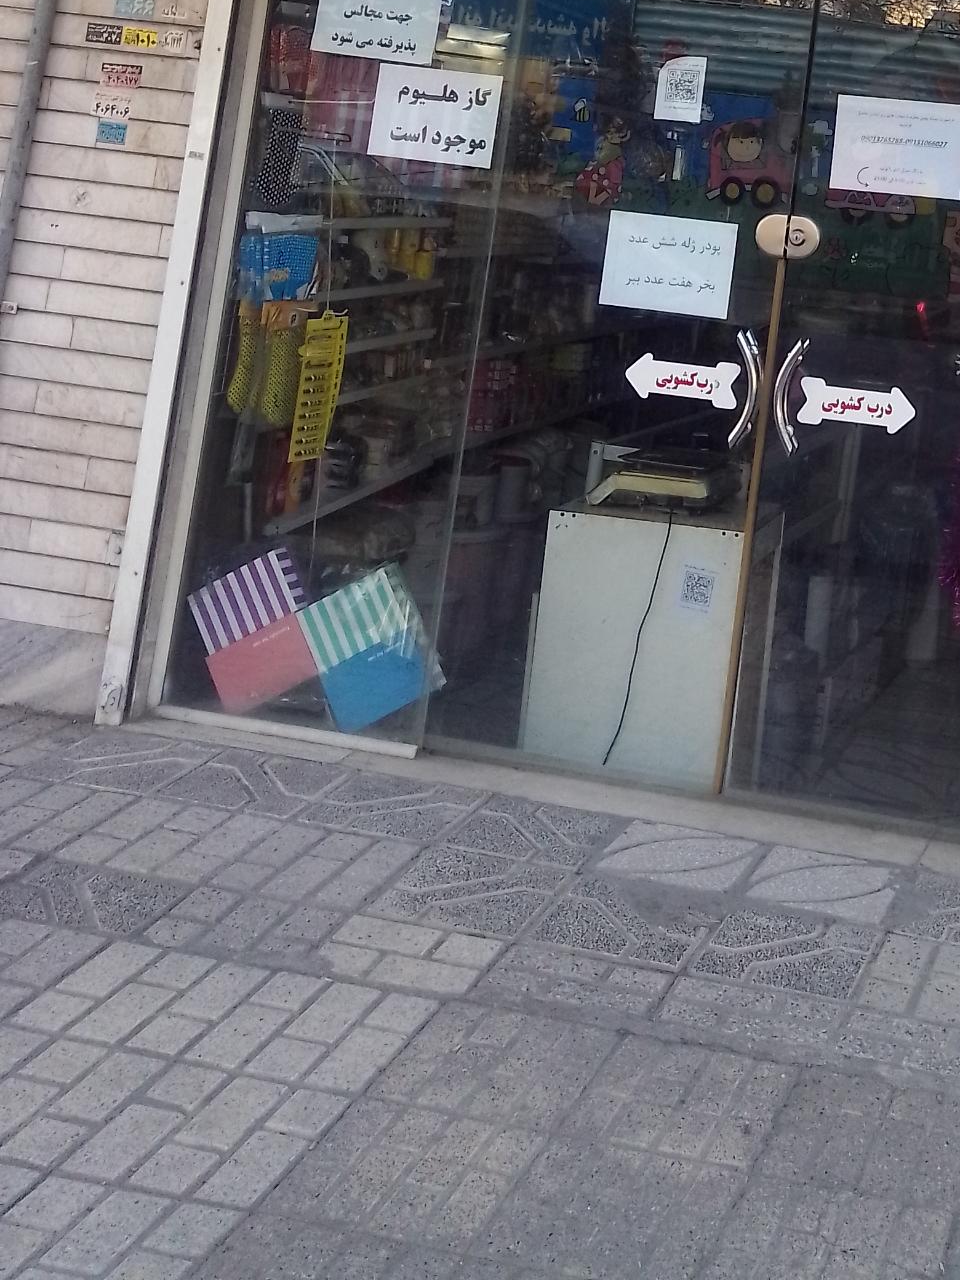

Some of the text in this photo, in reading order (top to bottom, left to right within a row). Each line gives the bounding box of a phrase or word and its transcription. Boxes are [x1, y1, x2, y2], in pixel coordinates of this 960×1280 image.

[343, 4, 413, 26] جهت مجالس
[331, 32, 417, 56] پذیرفته می شود
[397, 83, 492, 111] گاز هلیوم
[389, 125, 487, 155] موجود است
[628, 235, 721, 255] پودر ژله شش عدد
[644, 275, 664, 285] عدد
[668, 276, 693, 288] هفت
[697, 279, 715, 294] بخر
[655, 371, 698, 391] کشویی
[821, 397, 893, 419] درب کشویی
